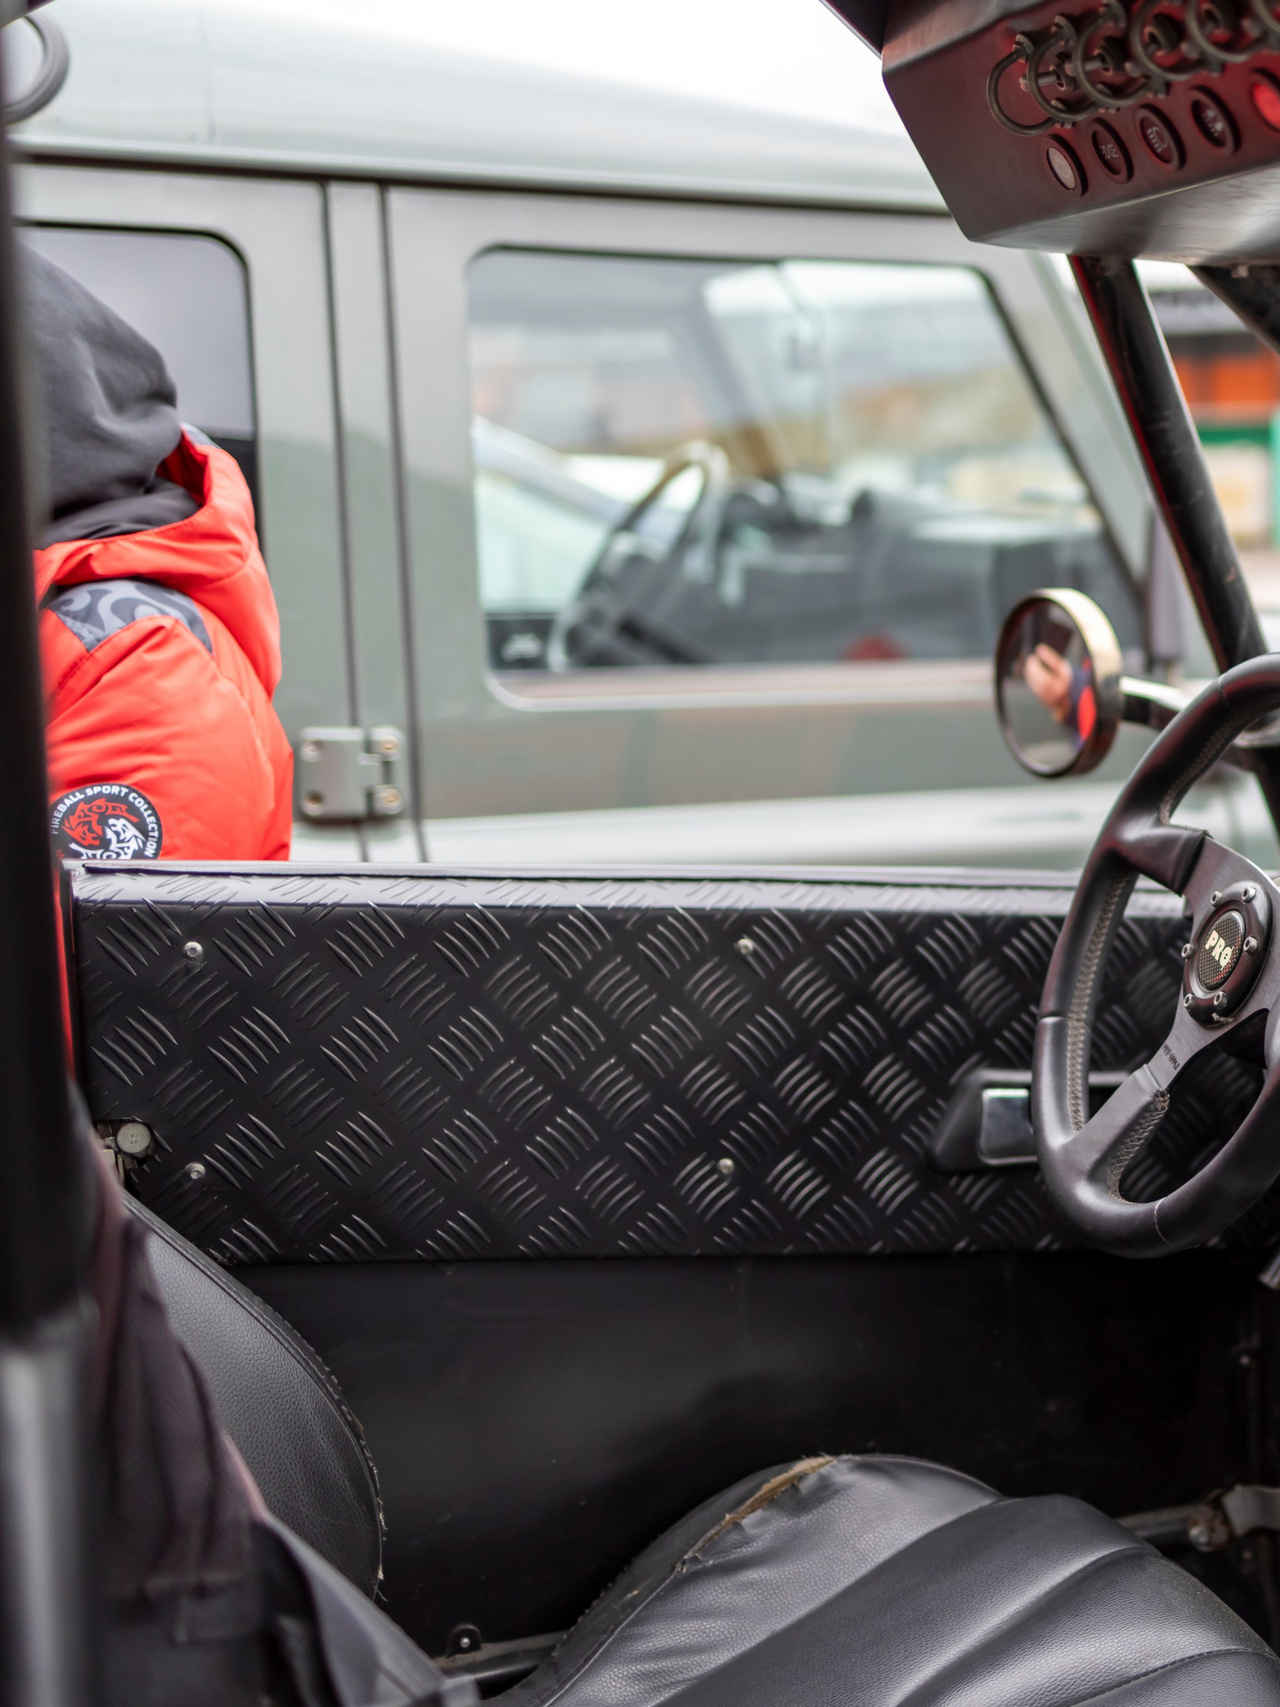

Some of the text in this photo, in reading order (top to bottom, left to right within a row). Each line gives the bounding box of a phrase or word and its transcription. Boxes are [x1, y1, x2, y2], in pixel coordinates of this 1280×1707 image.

[51, 784, 159, 858] FIREBALL SPORT COLLECTION
